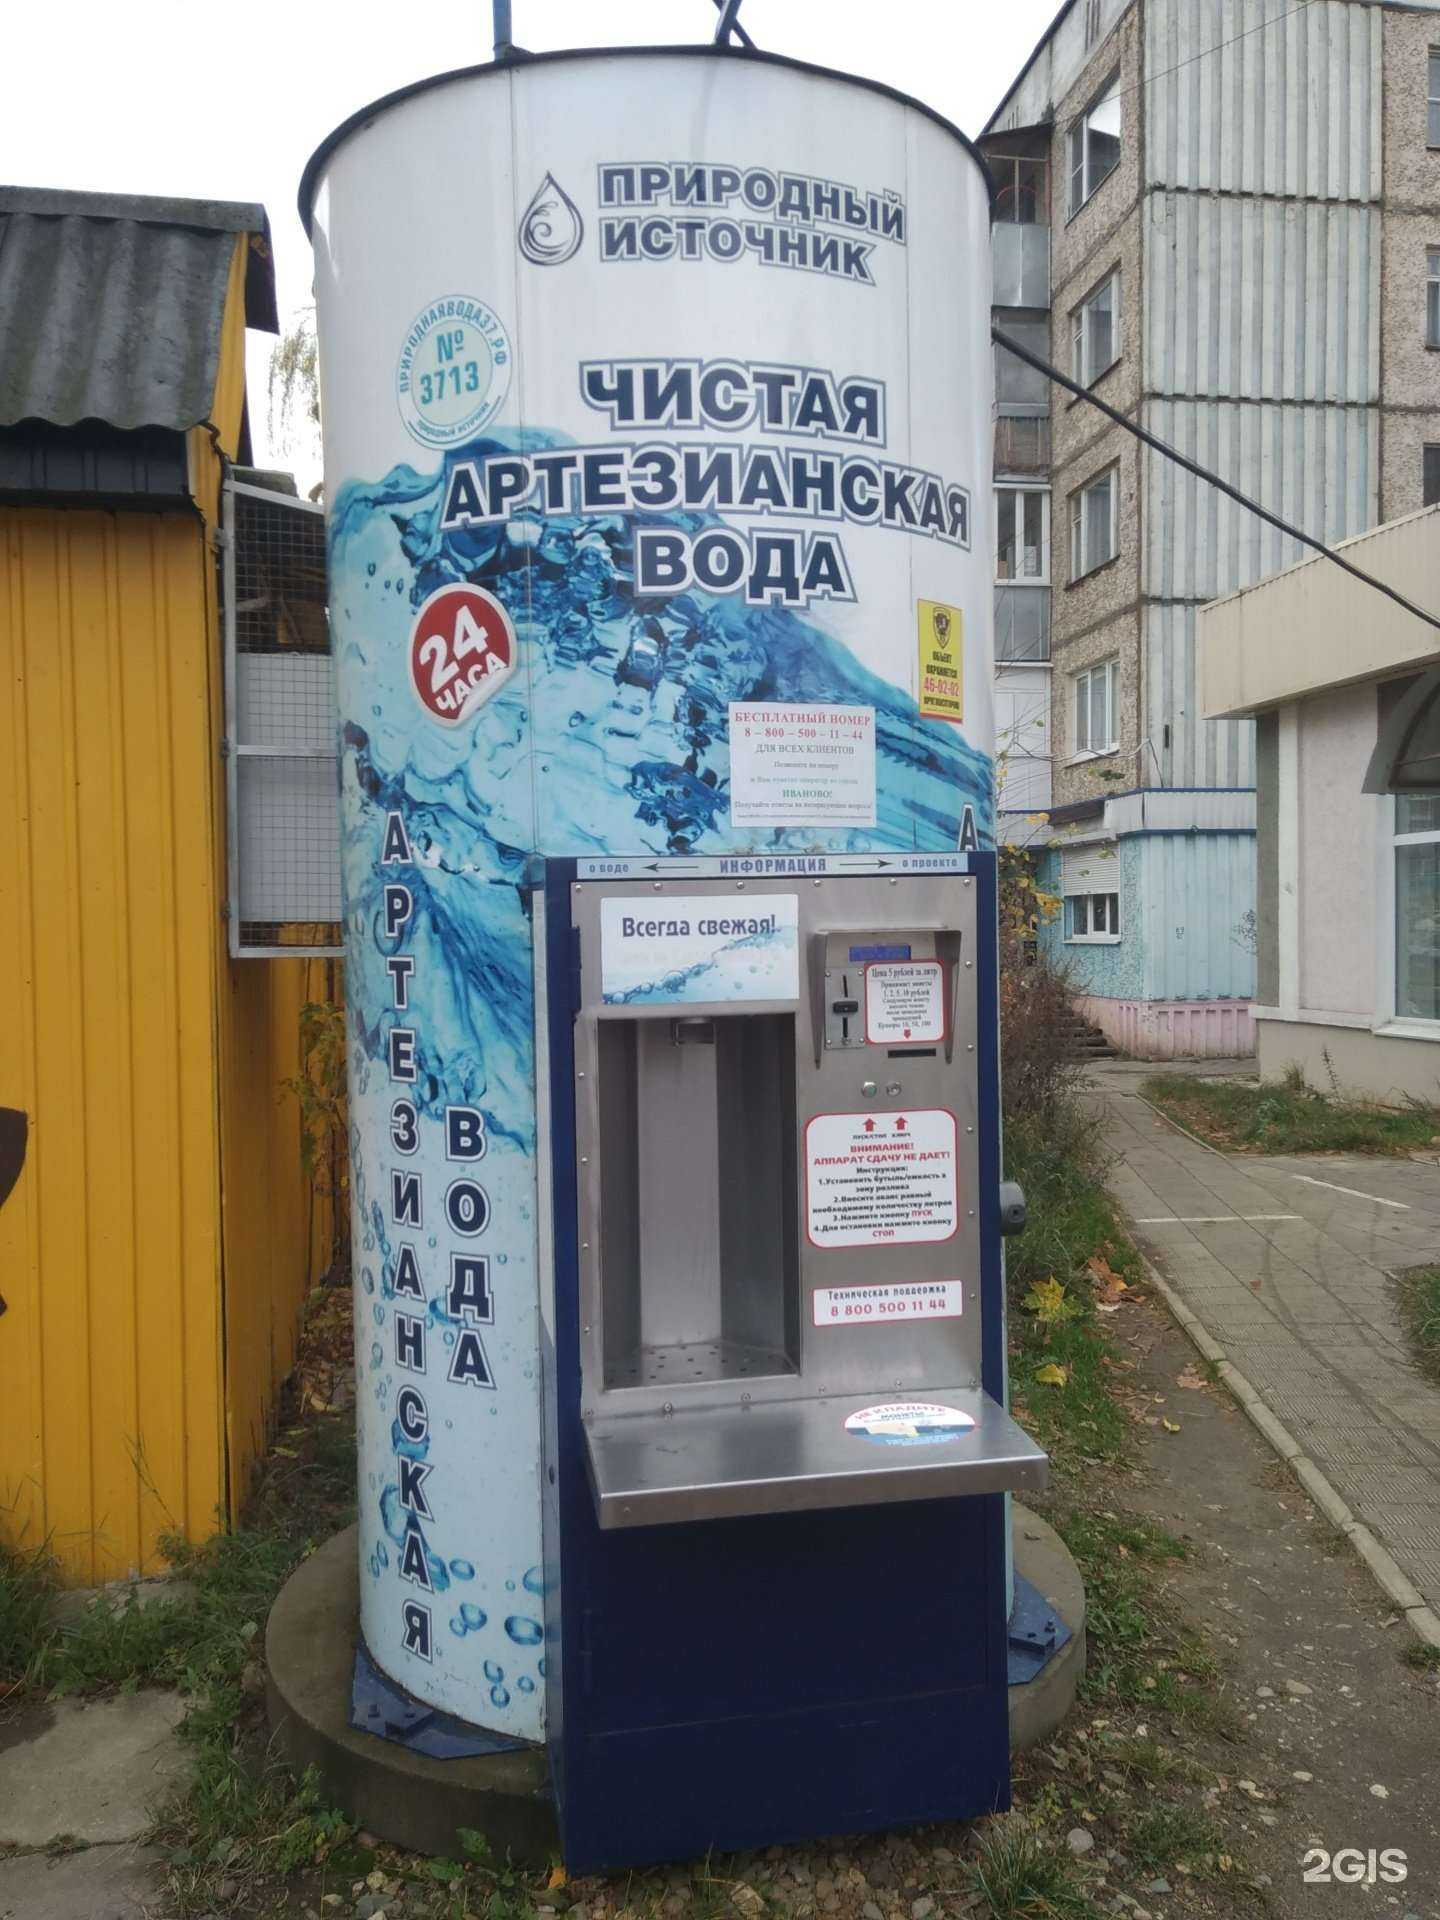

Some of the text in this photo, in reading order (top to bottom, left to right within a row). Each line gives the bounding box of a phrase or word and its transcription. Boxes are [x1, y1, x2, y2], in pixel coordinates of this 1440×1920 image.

[597, 162, 906, 246] ПРИРОДНЫЙ
[599, 215, 877, 287] ИСТОЧНИК
[436, 329, 464, 363] №
[420, 361, 479, 405] 3713
[578, 358, 886, 449] ЧИСТАЯ
[438, 441, 972, 552] АРТЕЗИАНСКАЯ
[633, 525, 859, 611] ВОДА
[419, 605, 489, 693] 24
[435, 651, 507, 711] ЧАСА
[735, 711, 871, 726] БЕСПЛАТНЫЙ НОМЕР
[745, 728, 751, 737] 8
[765, 728, 784, 738] 800
[798, 728, 816, 738] 500
[829, 729, 839, 739] 11
[852, 730, 863, 740] 44
[755, 744, 854, 755] ДЛЯ ВСЕХ КЛИЕНТОВ
[782, 790, 832, 799] ИВАНОВО!
[600, 864, 629, 873] воде
[719, 858, 827, 873] ИНФОРМАЦИЯ
[912, 859, 957, 868] проекте
[622, 914, 776, 938] Всегда свежая!
[850, 1142, 914, 1153] ВНИМАНИЕ!
[814, 1151, 950, 1166] АППАРАТ СДАЧУ НЕ ДАЕТ!
[856, 1165, 908, 1175] Инструкция:
[911, 1209, 933, 1217] ПУСК
[381, 810, 435, 1664] АРТЕЗИАНСКАЯ
[872, 1230, 895, 1238] СТОП
[444, 1104, 497, 1389] ВОДА
[828, 1285, 947, 1301] Техническая поддержка
[831, 1298, 946, 1317] 8 800 500 11 44
